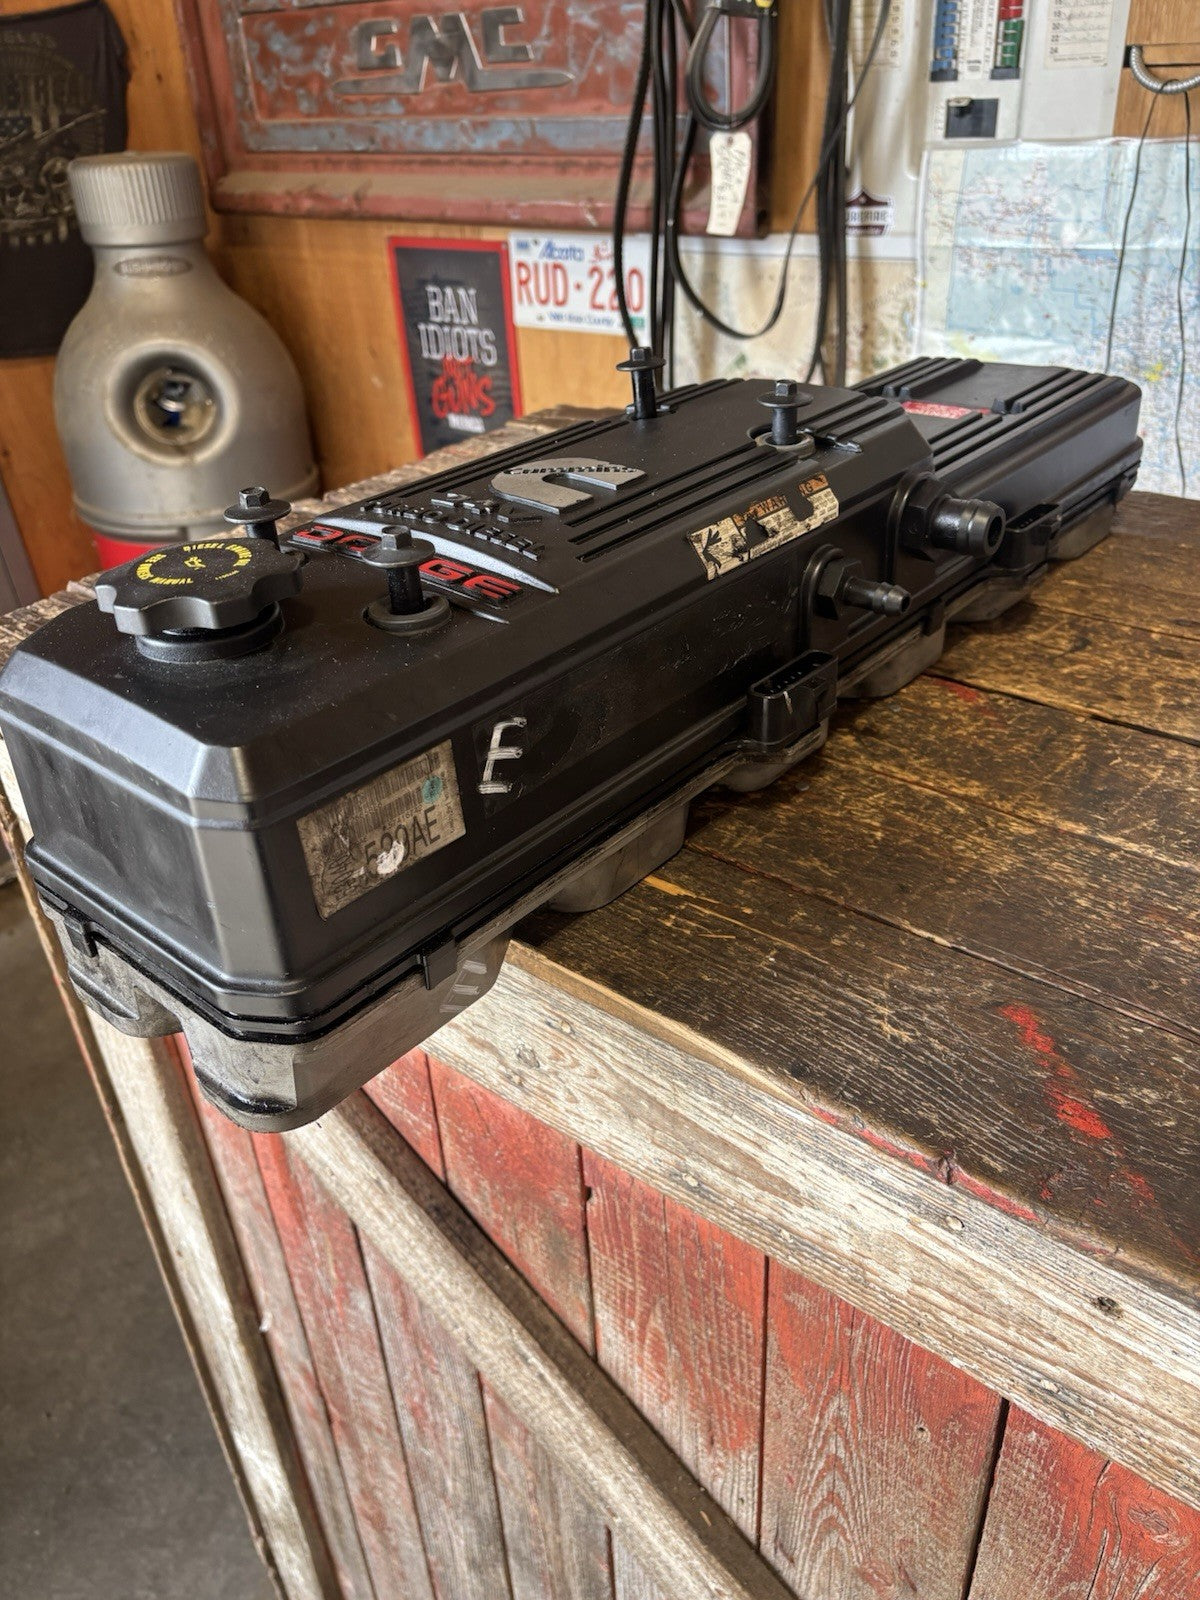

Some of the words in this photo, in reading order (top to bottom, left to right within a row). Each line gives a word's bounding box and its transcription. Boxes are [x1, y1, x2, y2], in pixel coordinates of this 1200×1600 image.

[334, 7, 575, 95] GMC
[425, 284, 479, 325] BAN
[417, 322, 498, 367] IDIOTS
[431, 373, 496, 419] GUNS
[183, 543, 225, 553] DIESEL
[292, 524, 523, 600] DOGE
[148, 577, 195, 585] MANUAL
[479, 716, 528, 795] E
